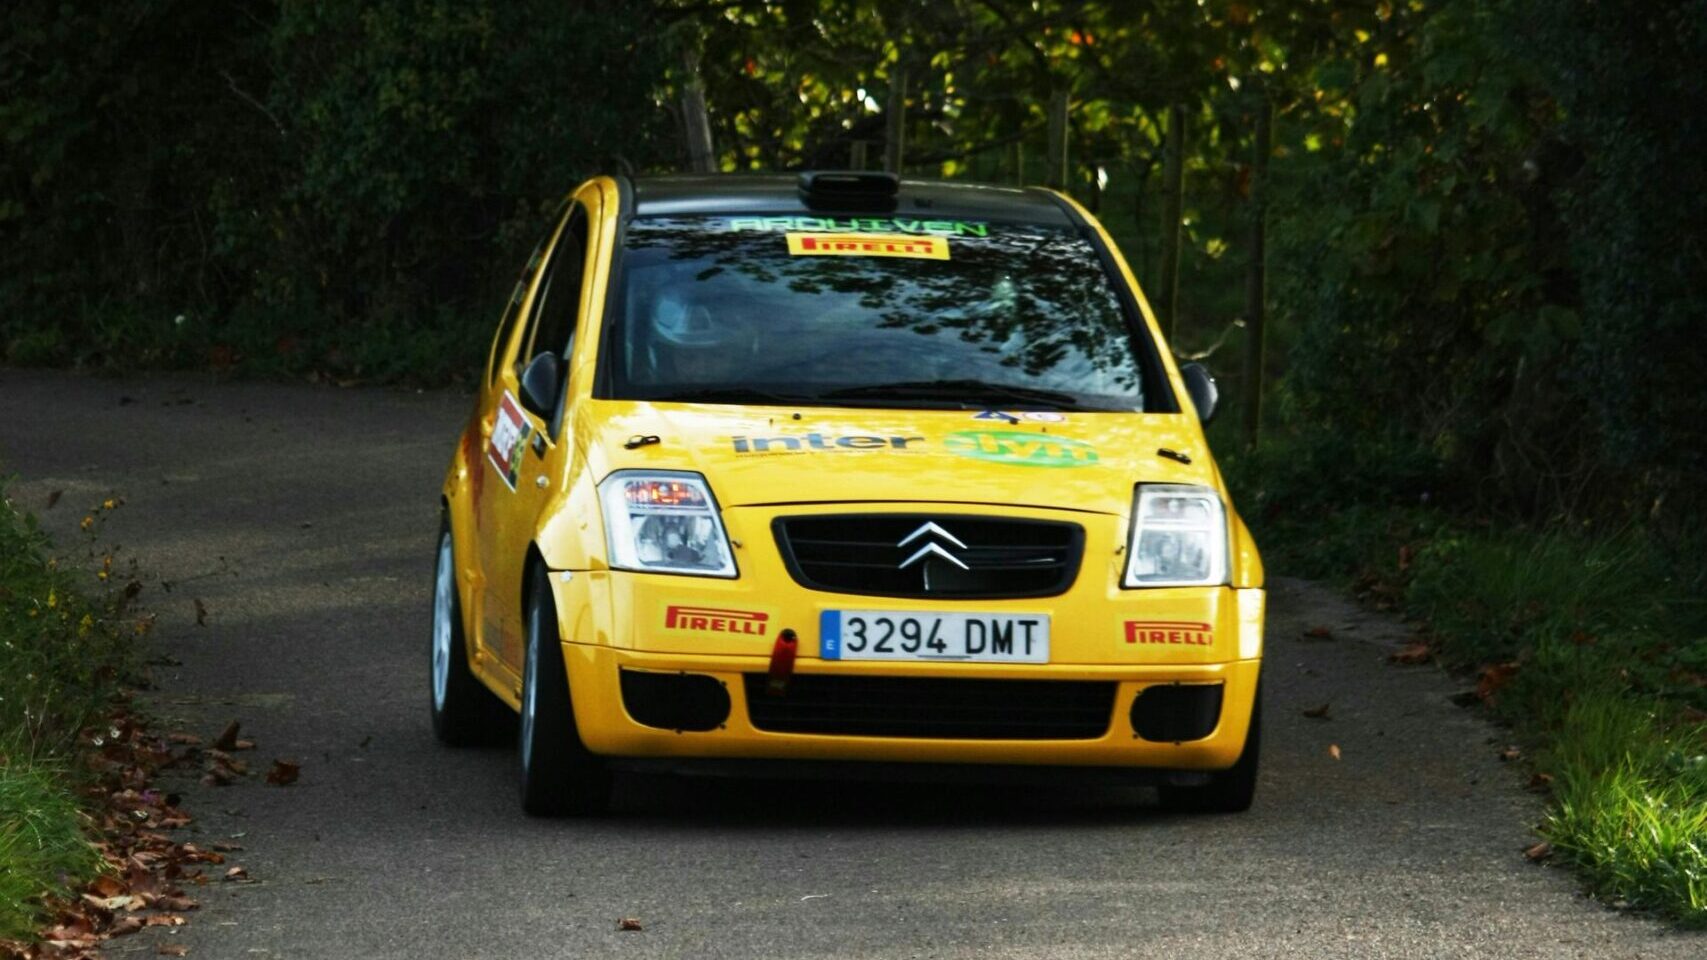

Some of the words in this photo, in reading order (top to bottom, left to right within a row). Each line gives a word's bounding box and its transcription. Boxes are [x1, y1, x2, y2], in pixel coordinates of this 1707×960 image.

[801, 237, 933, 254] PIRELLI
[731, 432, 925, 453] inter
[665, 605, 769, 636] PIRELLI
[825, 639, 835, 650] E
[847, 617, 947, 654] 3294
[964, 618, 1039, 656] DMT
[1124, 620, 1214, 646] PIRELLI
